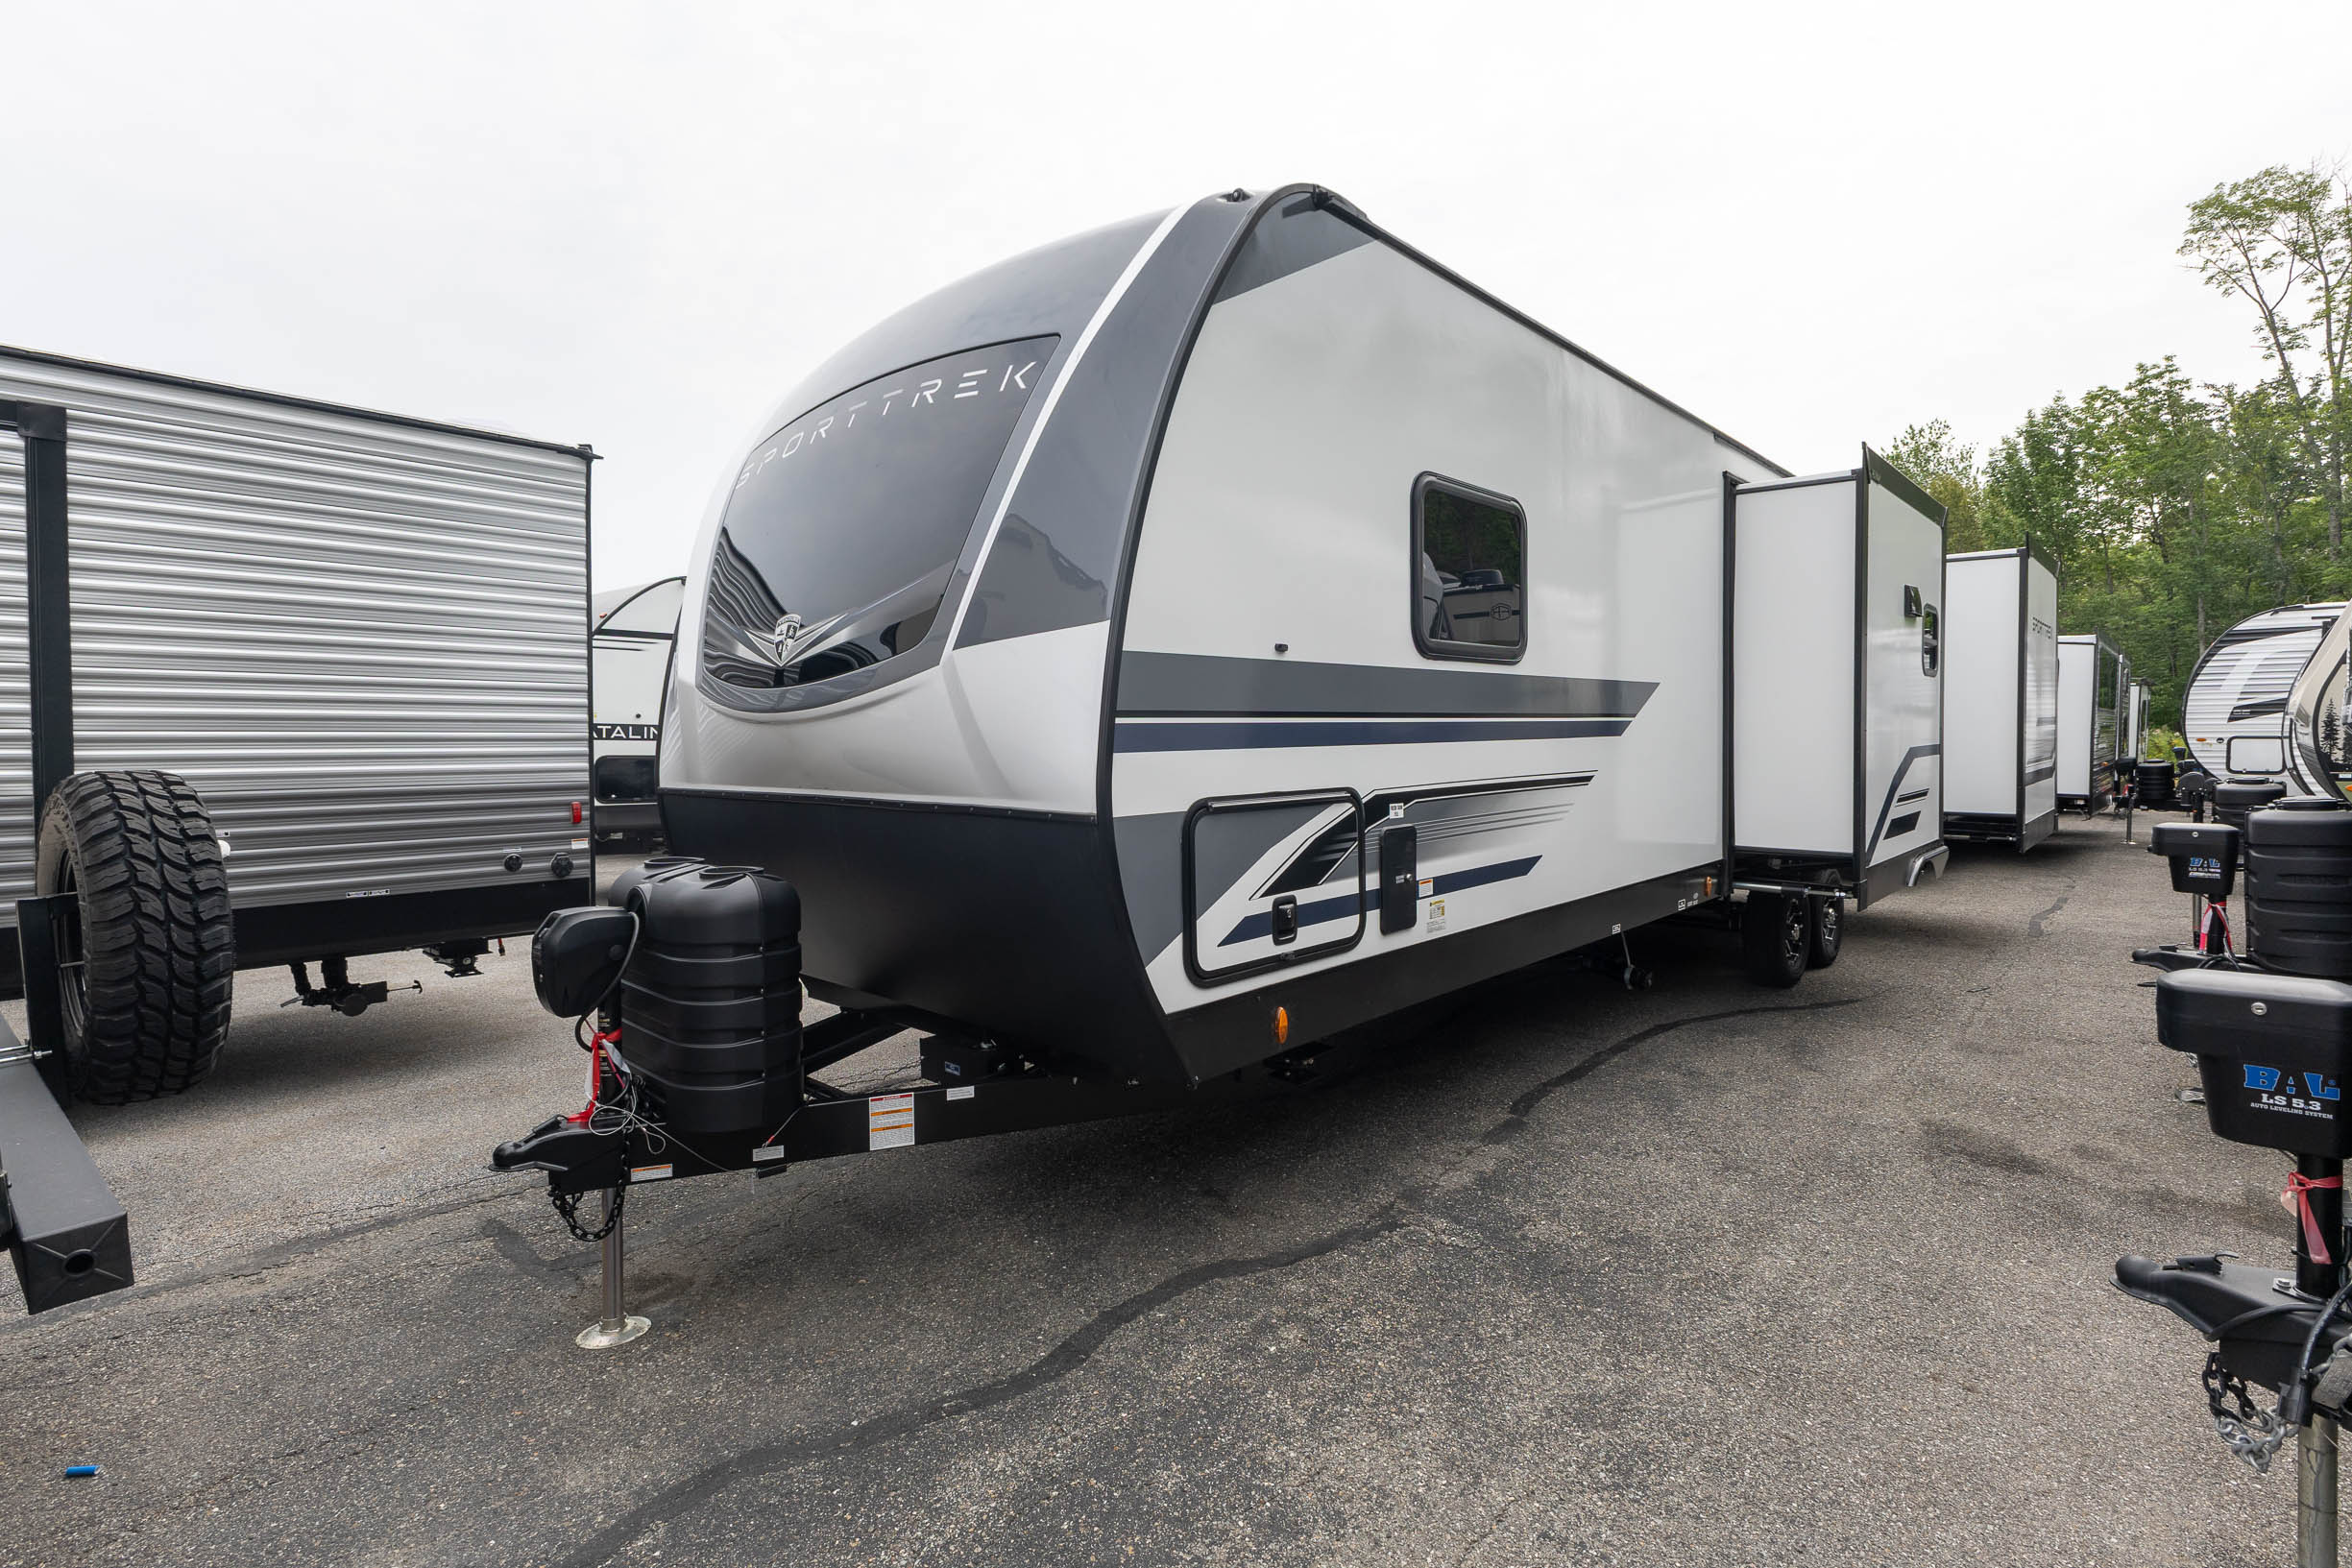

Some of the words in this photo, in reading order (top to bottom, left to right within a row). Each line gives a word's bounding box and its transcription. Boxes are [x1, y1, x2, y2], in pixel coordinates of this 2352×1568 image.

[735, 361, 1037, 490] SPORTTREK
[2243, 1064, 2340, 1100] BAL
[2261, 1093, 2287, 1105] LS
[2291, 1098, 2321, 1111] 5.3
[2269, 1104, 2303, 1114] LEVELING
[2305, 1110, 2334, 1120] SYSTEM
